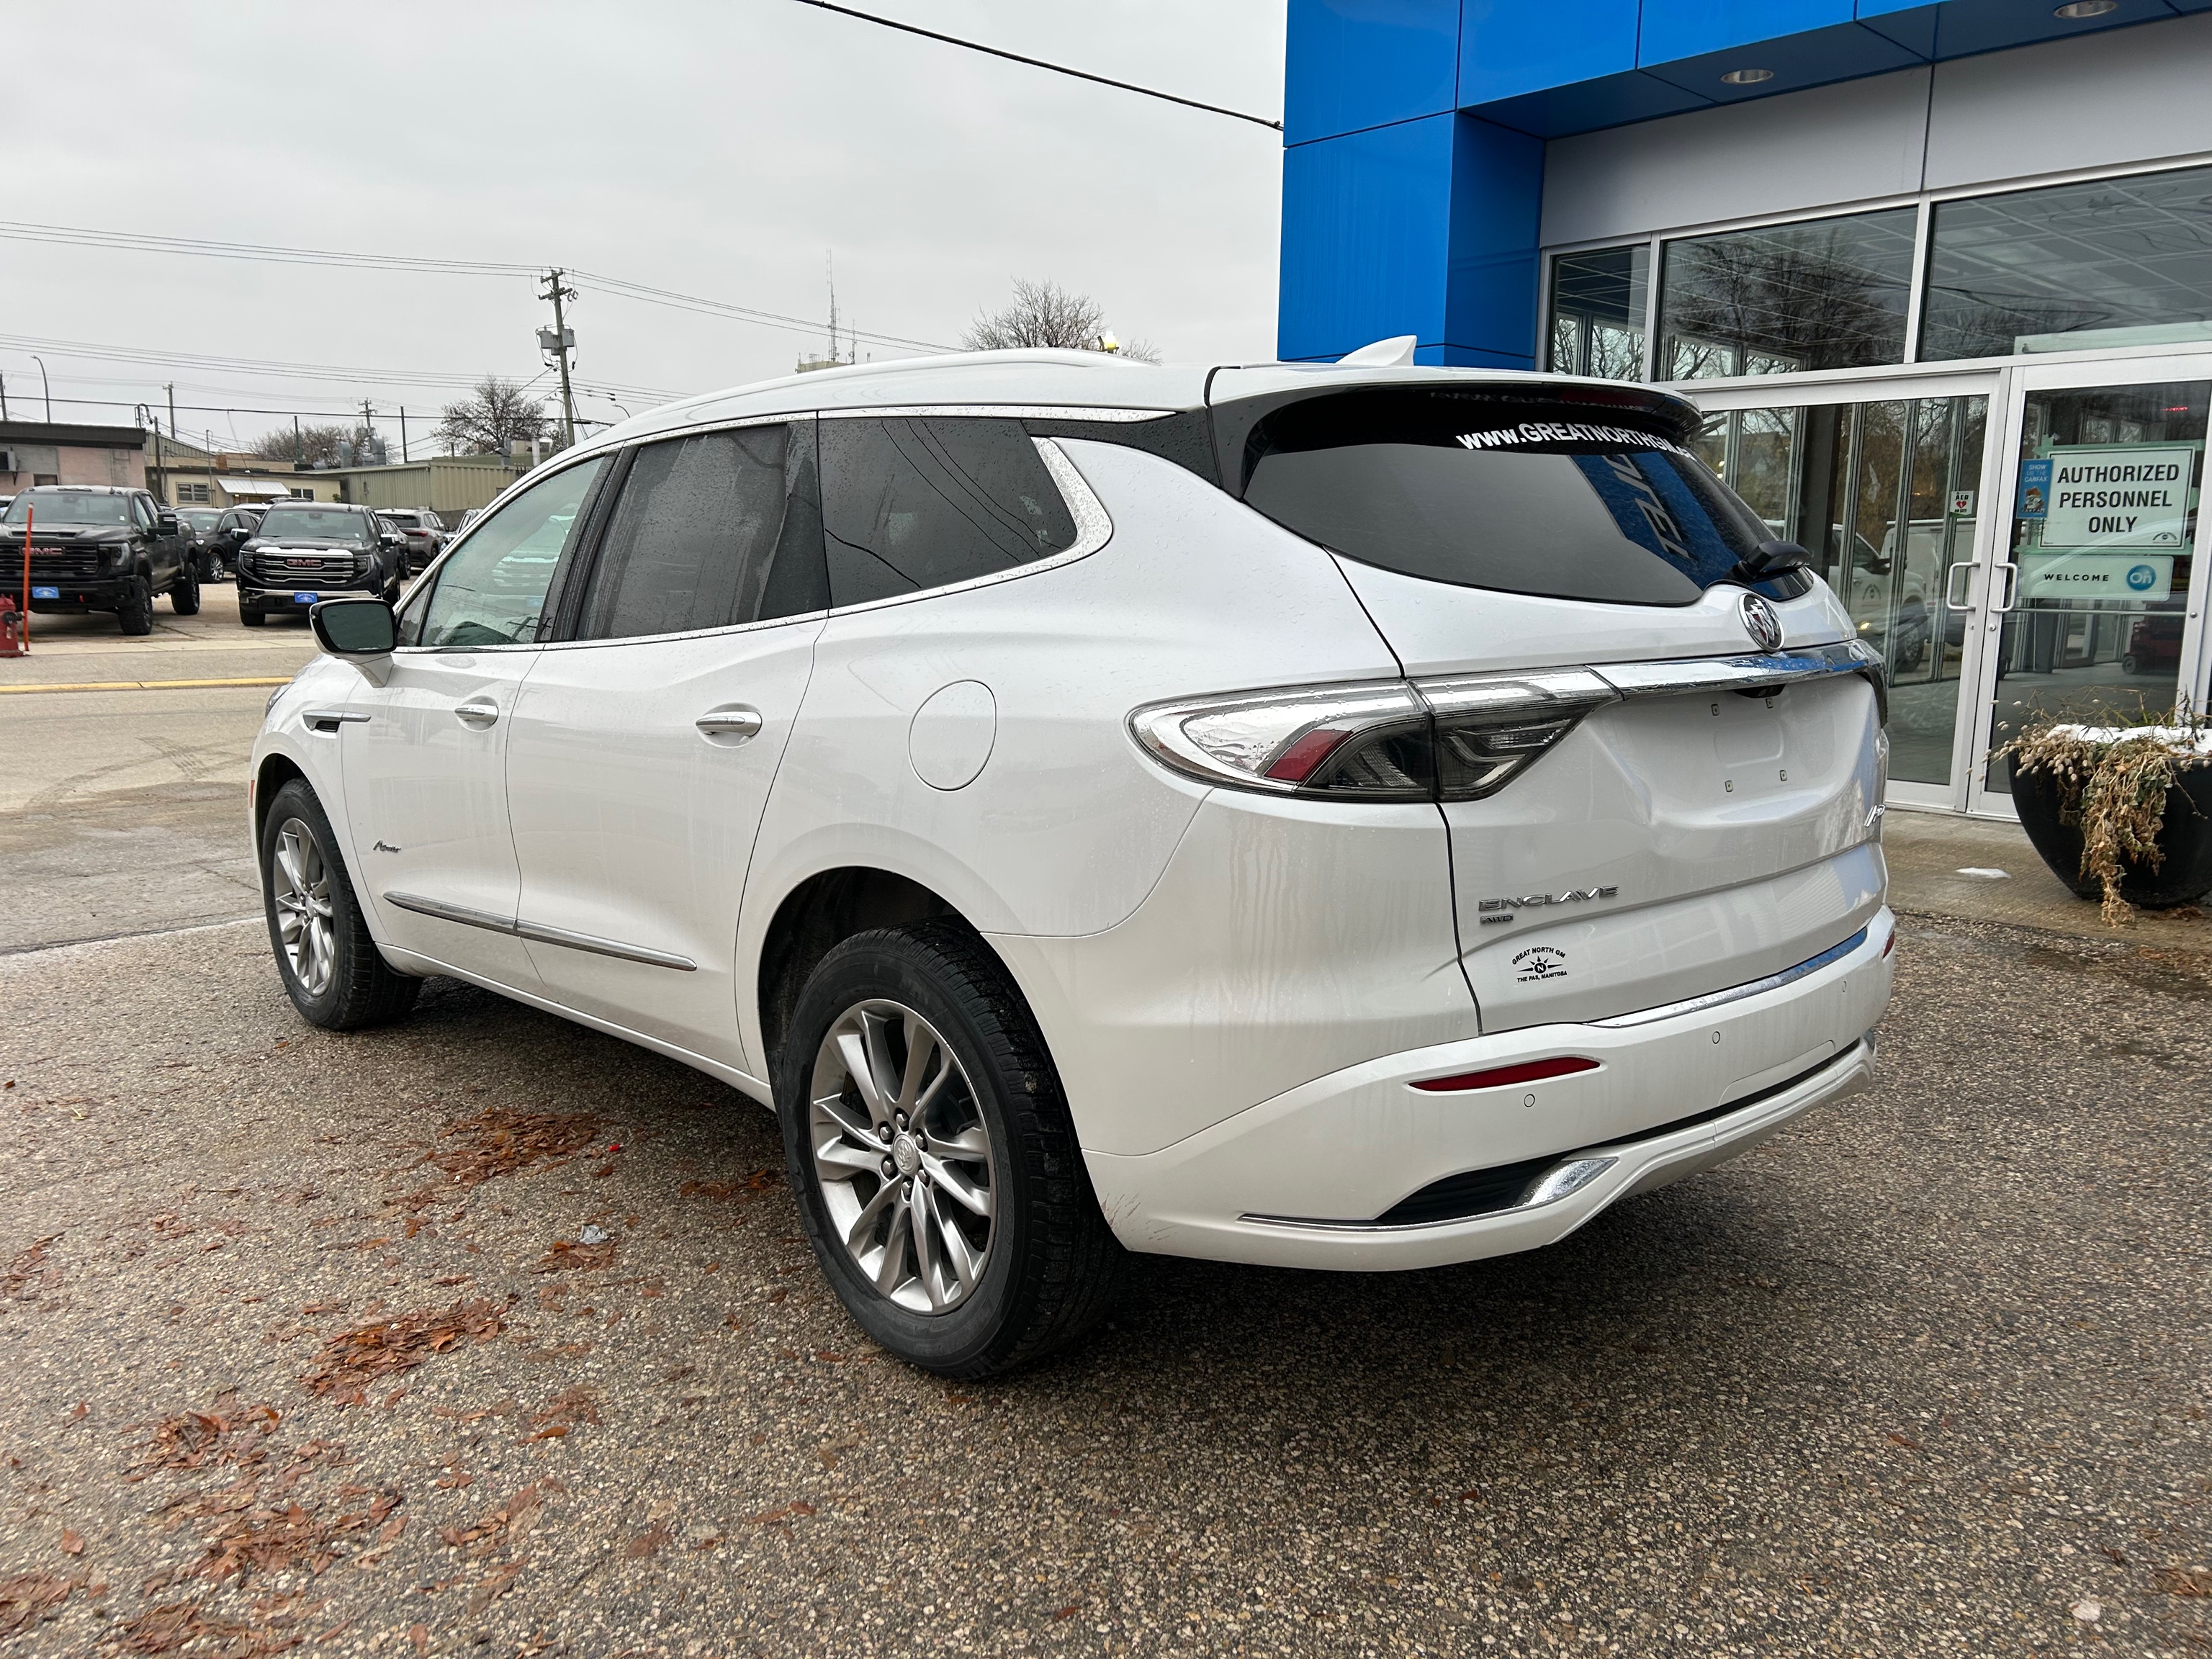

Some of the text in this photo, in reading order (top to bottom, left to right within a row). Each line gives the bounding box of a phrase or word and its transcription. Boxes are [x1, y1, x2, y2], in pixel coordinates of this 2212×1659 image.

[2057, 464, 2180, 484] AUTHORIZED
[2059, 490, 2172, 508] PERSONNEL
[2088, 516, 2138, 533] ONLY
[1478, 885, 1619, 911] ENCLAVE
[1481, 914, 1514, 924] AWD
[1512, 949, 1531, 965] GREAT
[1555, 950, 1566, 958] GM
[1541, 971, 1568, 979] MANITOBA
